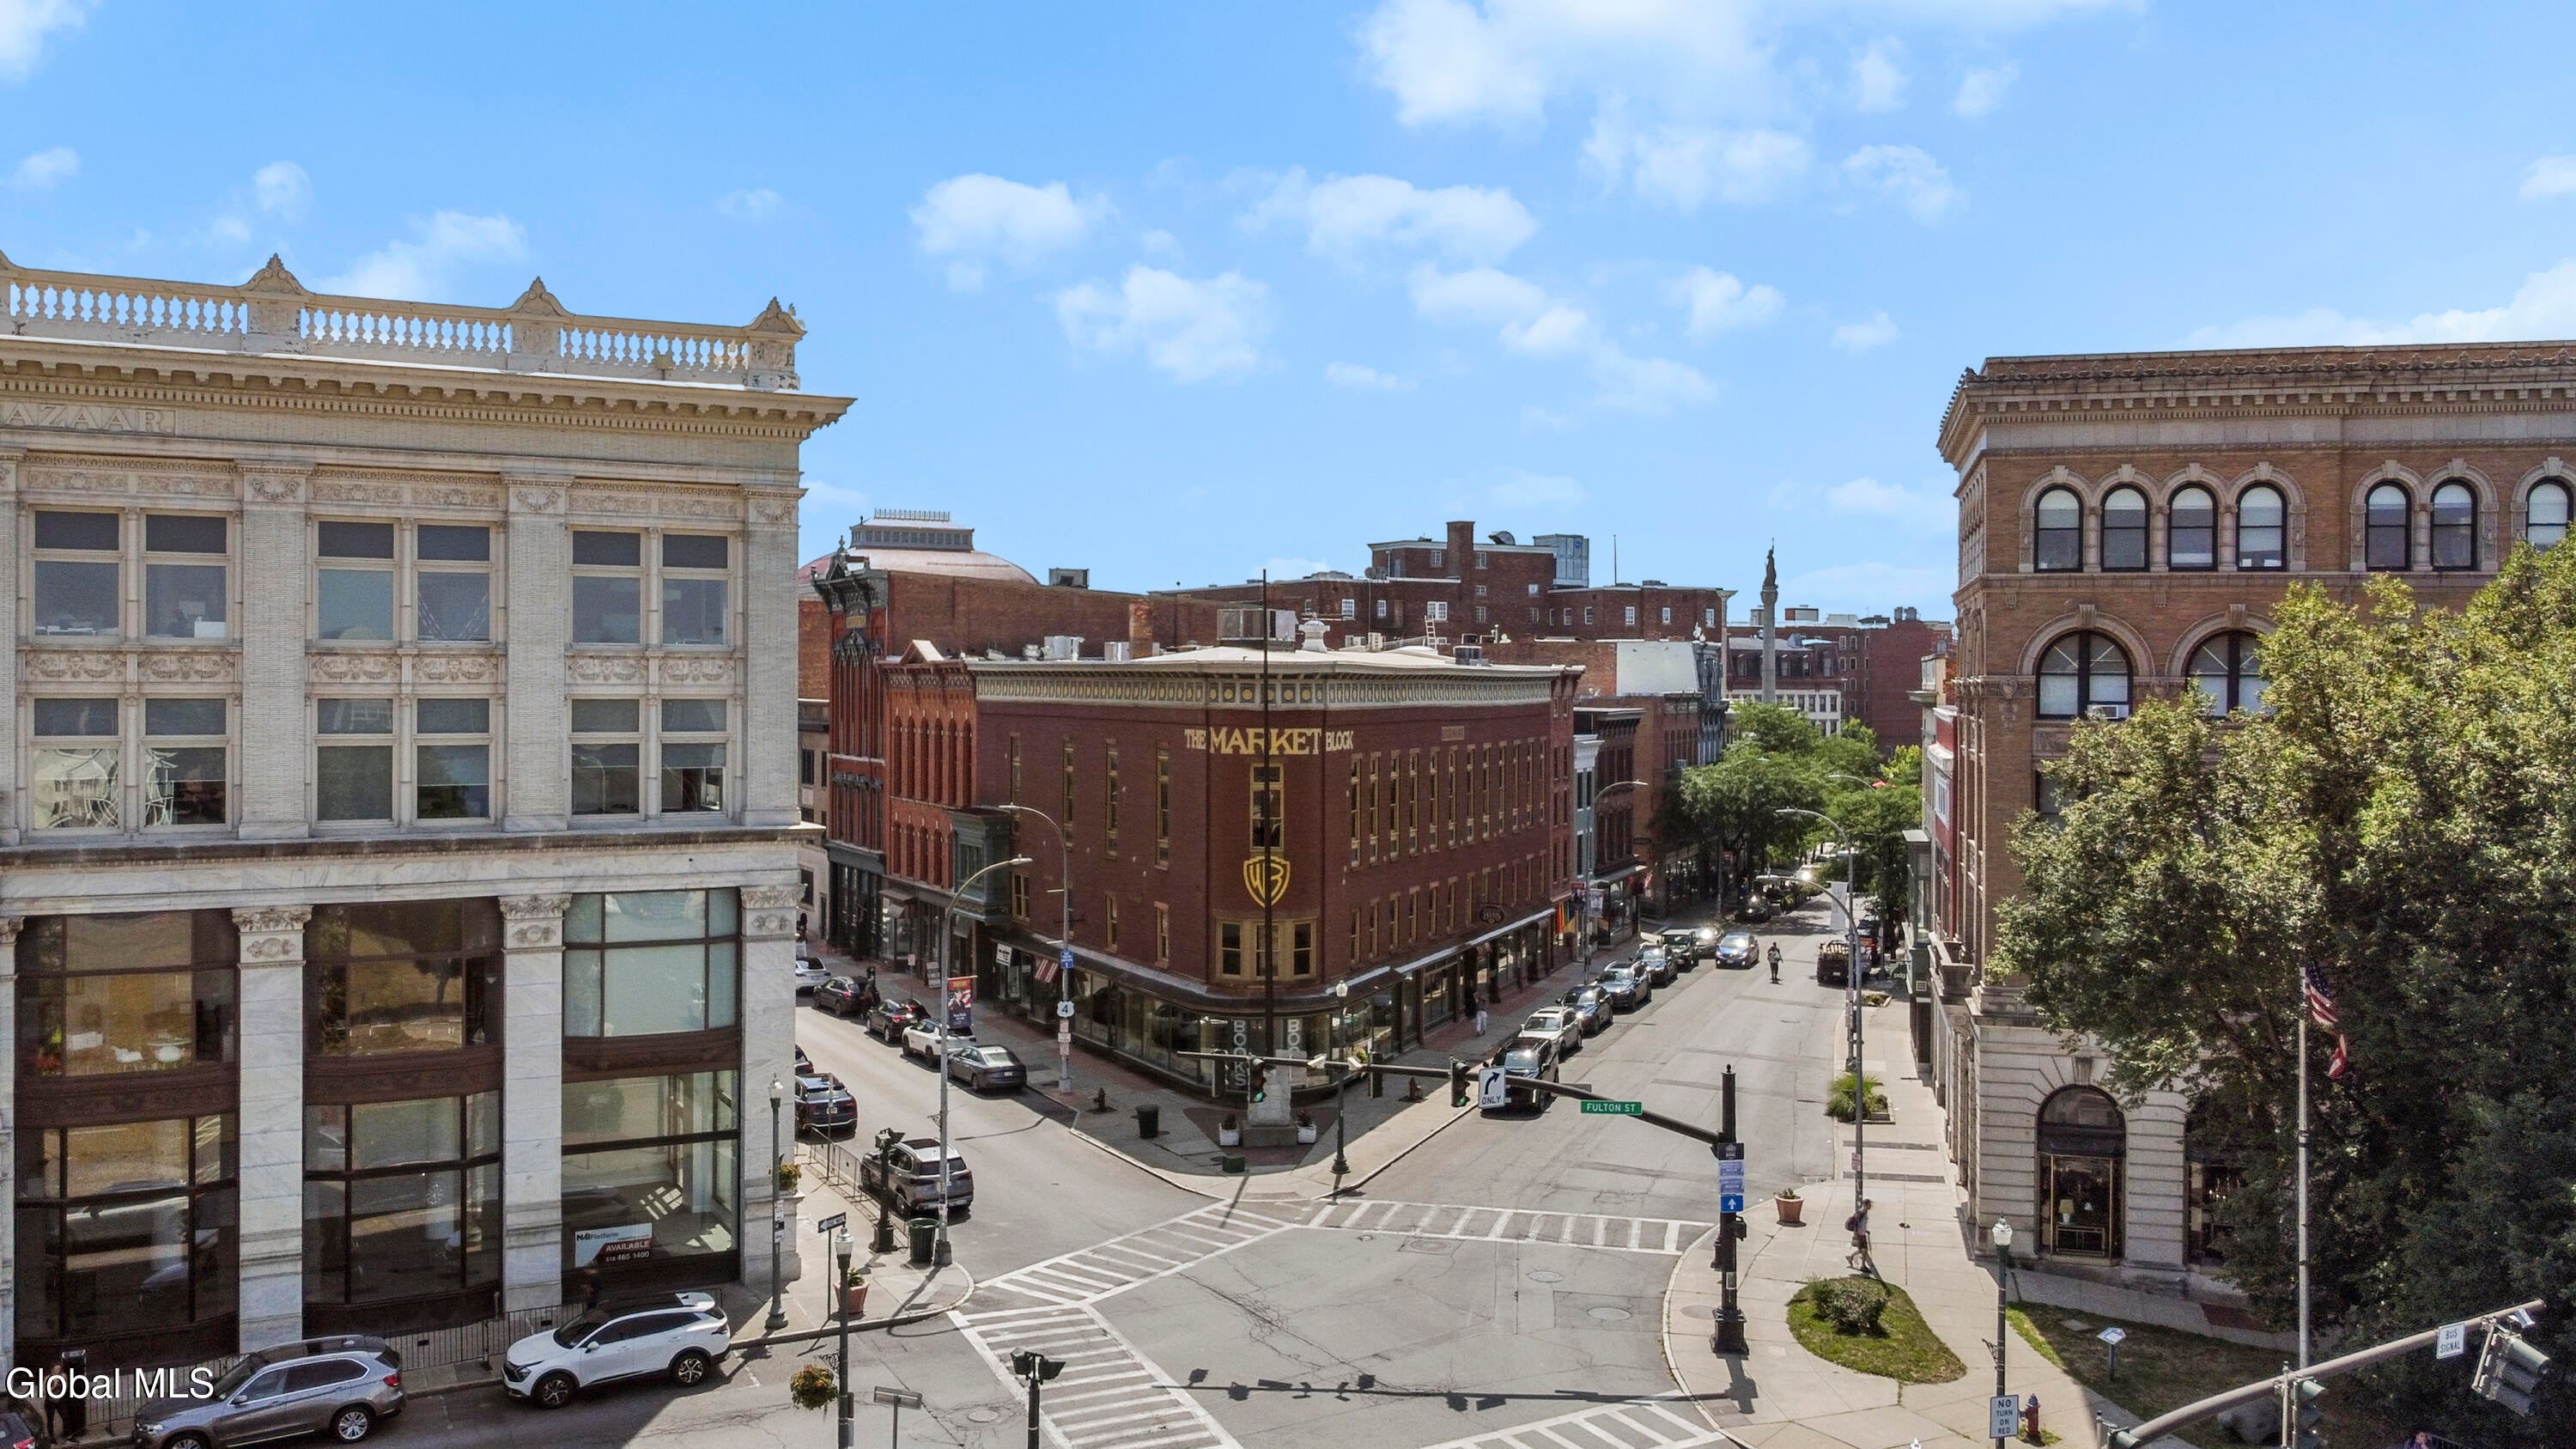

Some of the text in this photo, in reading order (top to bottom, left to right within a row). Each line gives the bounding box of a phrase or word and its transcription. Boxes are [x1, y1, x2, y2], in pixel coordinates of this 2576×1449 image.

[1184, 727, 1354, 755] THE MARKET BLOCK
[1061, 1004, 1068, 1014] 4
[1233, 1020, 1247, 1087] BOOKS
[1481, 1094, 1501, 1105] ONLY
[1586, 1103, 1636, 1112] FULTON ST
[605, 1240, 650, 1252] AVAILABLE
[633, 1251, 650, 1259] 1400
[2445, 1329, 2458, 1340] BUS
[2439, 1340, 2461, 1354] SIGNAL
[1998, 1399, 2012, 1408] NO
